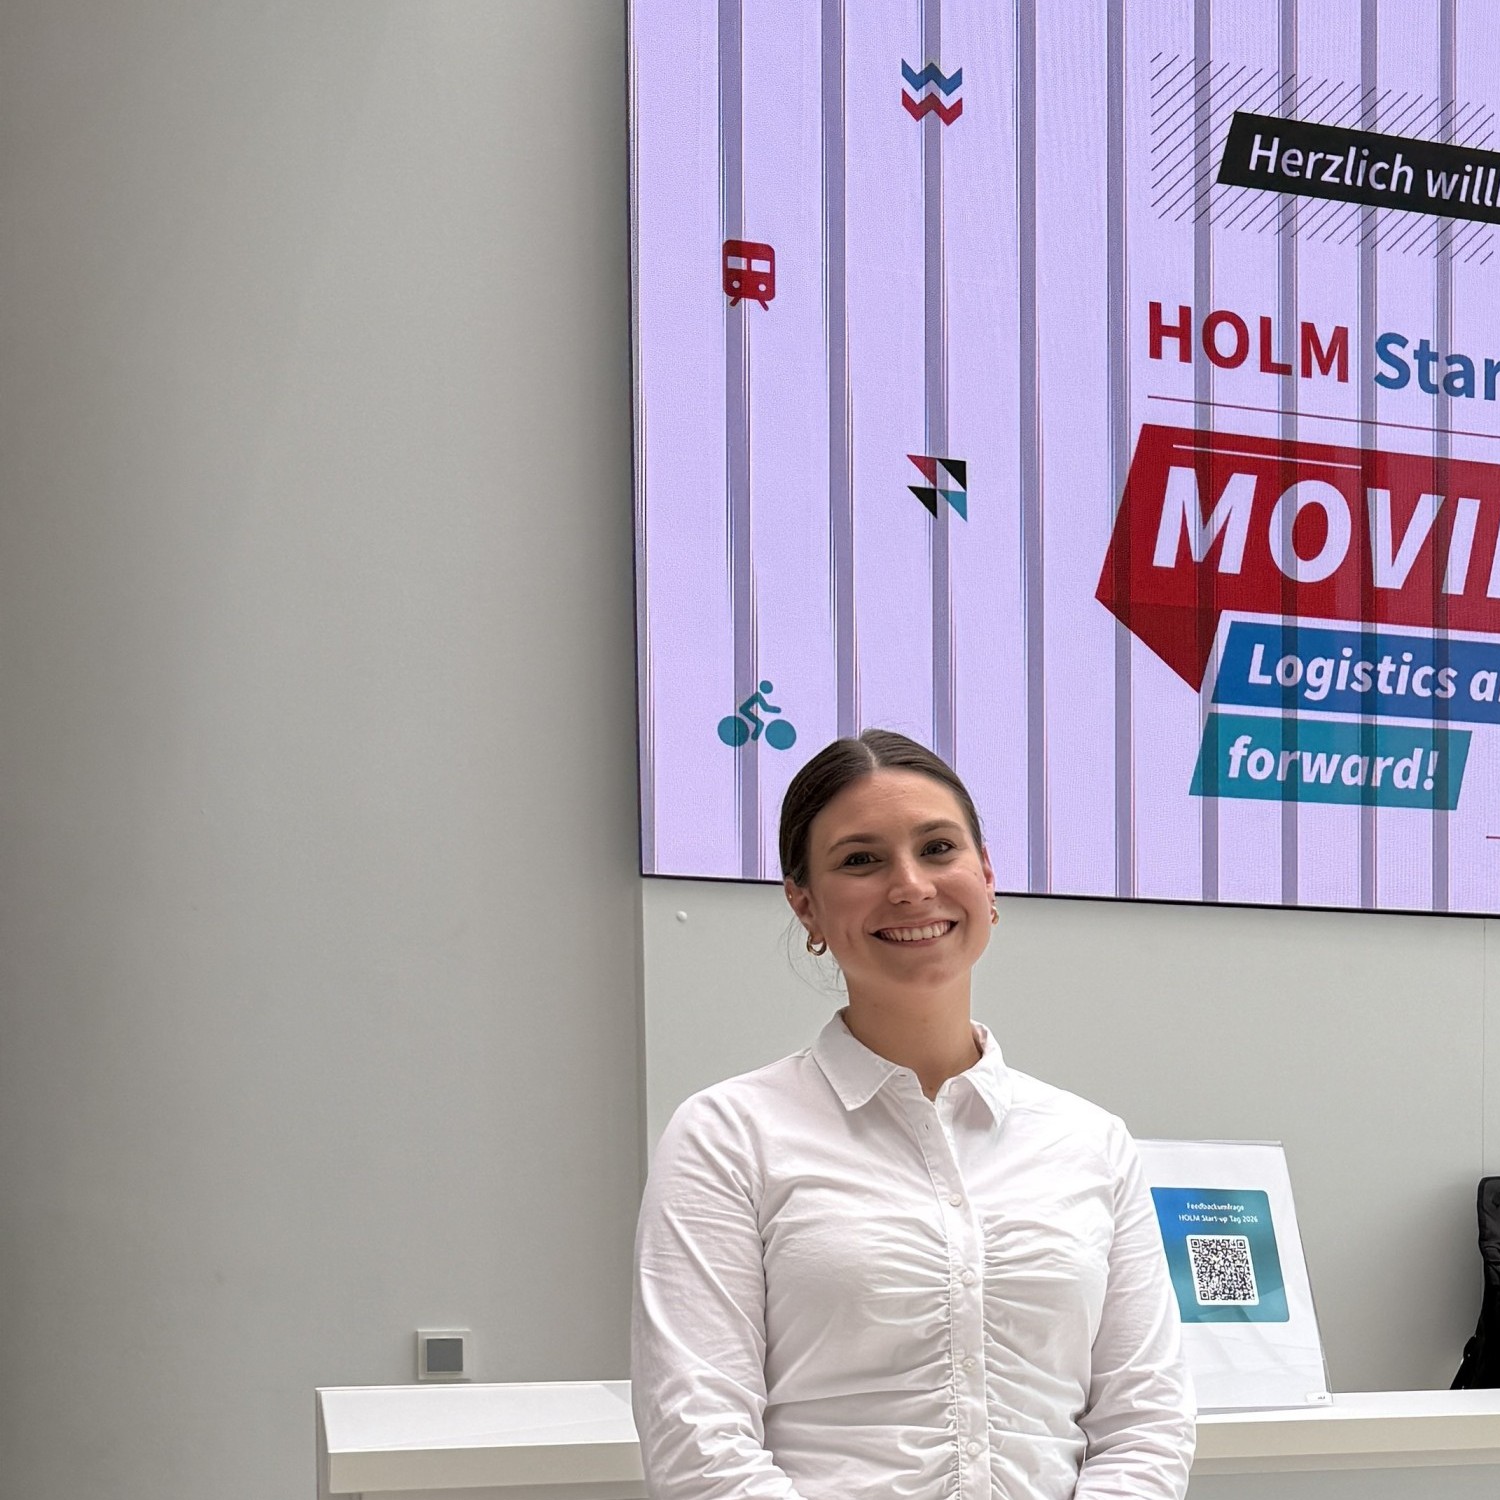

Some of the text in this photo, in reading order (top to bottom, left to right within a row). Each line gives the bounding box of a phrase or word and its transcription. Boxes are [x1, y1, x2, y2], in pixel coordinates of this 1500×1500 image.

[1247, 132, 1415, 197] Herzlich
[1147, 300, 1351, 384] HOLM
[1248, 642, 1458, 702] Logistics
[1227, 734, 1439, 792] forward!
[1242, 1215, 1258, 1223] 2026
